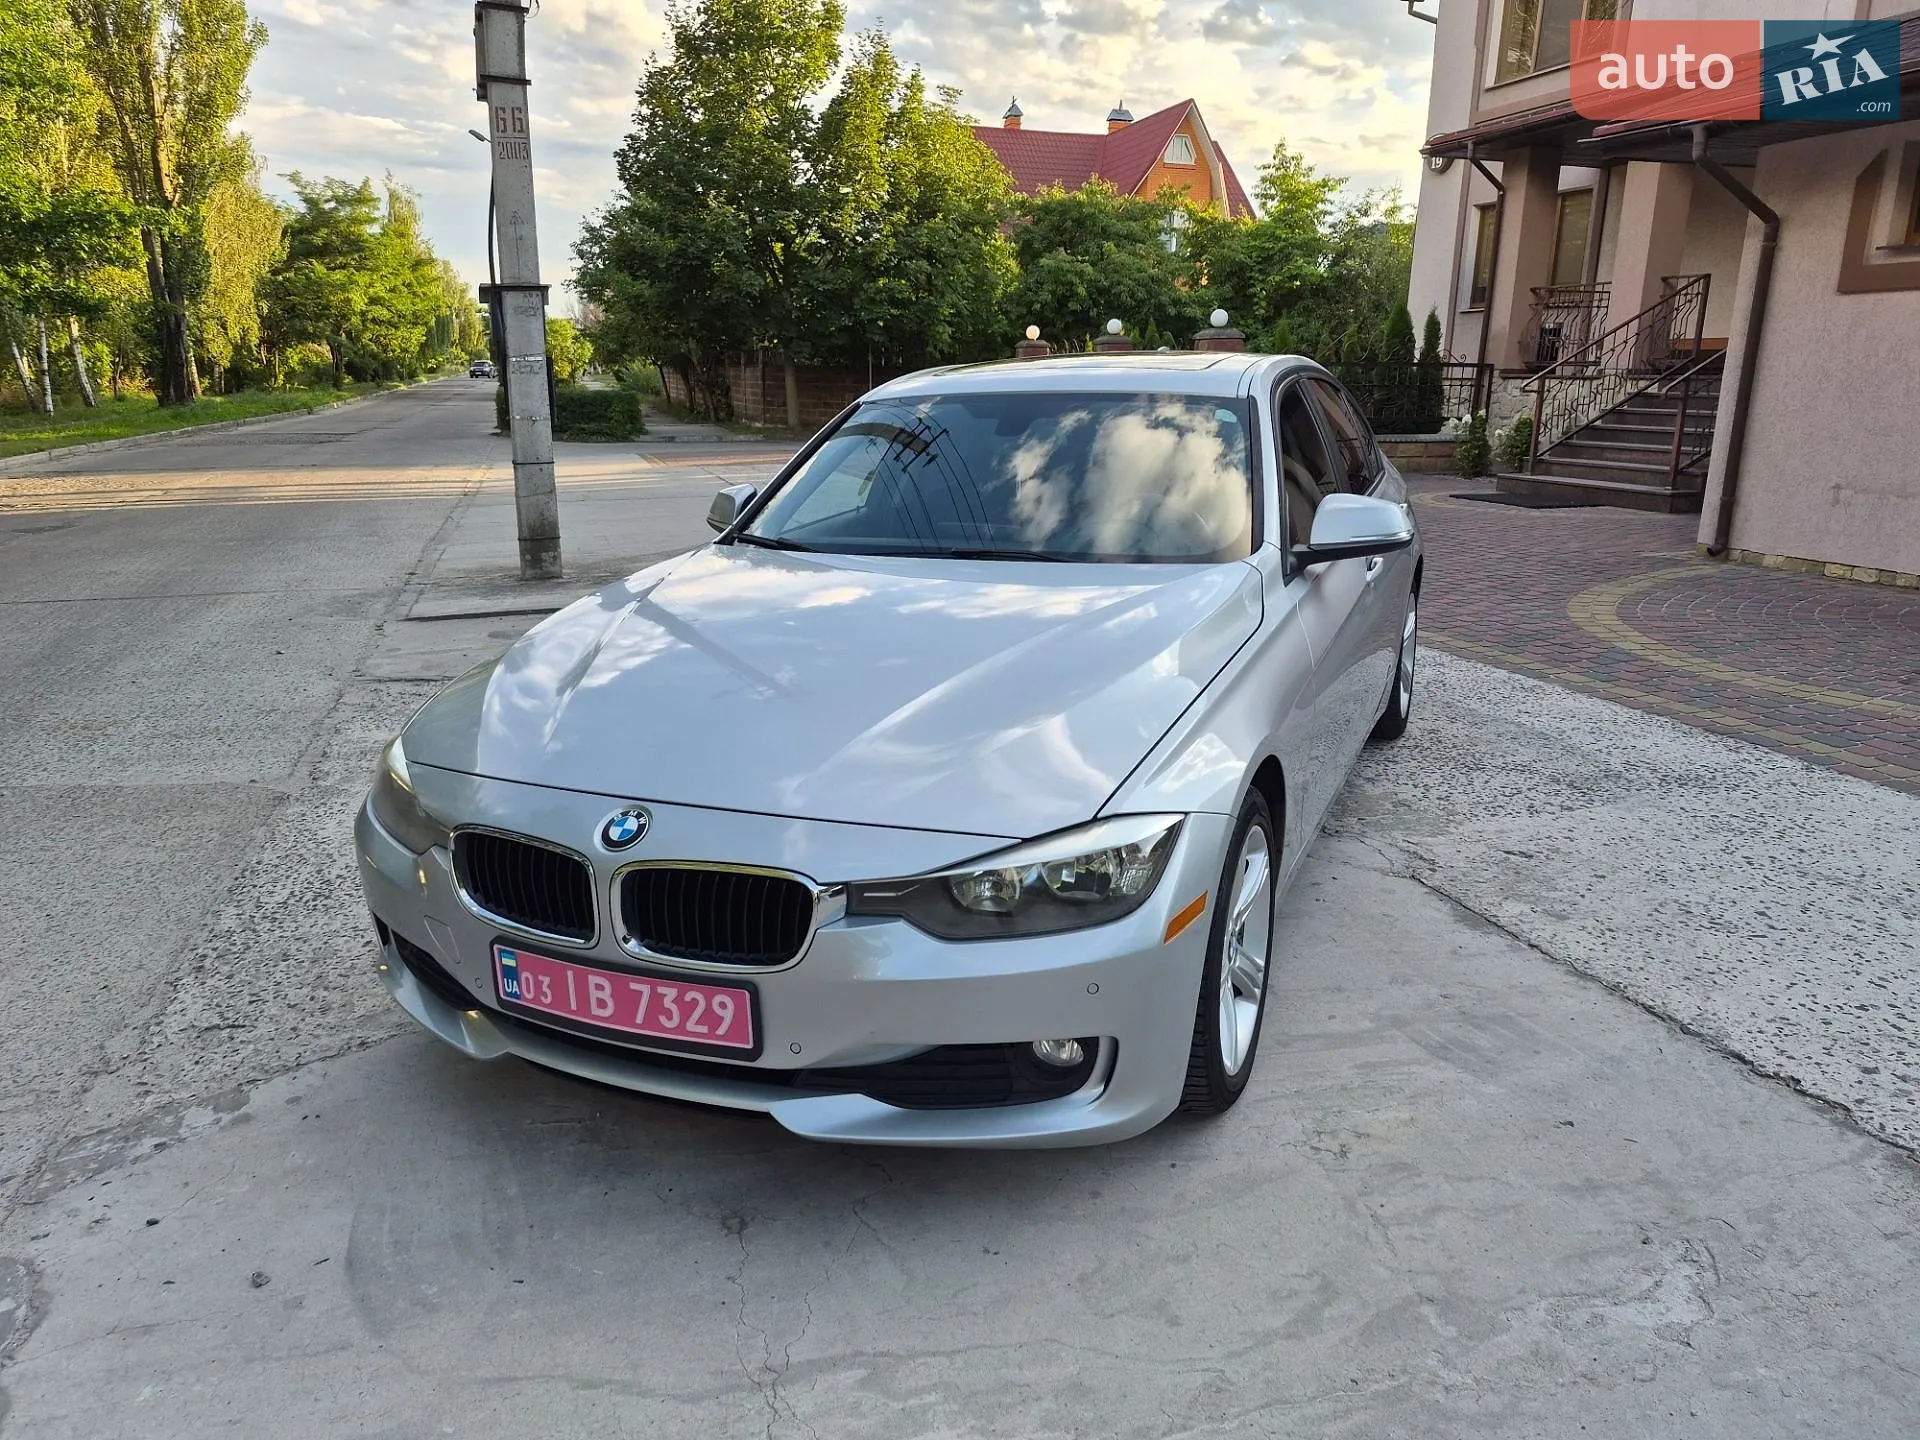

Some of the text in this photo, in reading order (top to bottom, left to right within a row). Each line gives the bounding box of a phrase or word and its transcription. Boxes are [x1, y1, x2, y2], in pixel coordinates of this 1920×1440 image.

[498, 141, 529, 159] 2003
[1431, 156, 1443, 168] 19
[613, 810, 647, 825] BMW
[503, 980, 520, 996] UA
[521, 970, 736, 1037] 03 IB 7329
